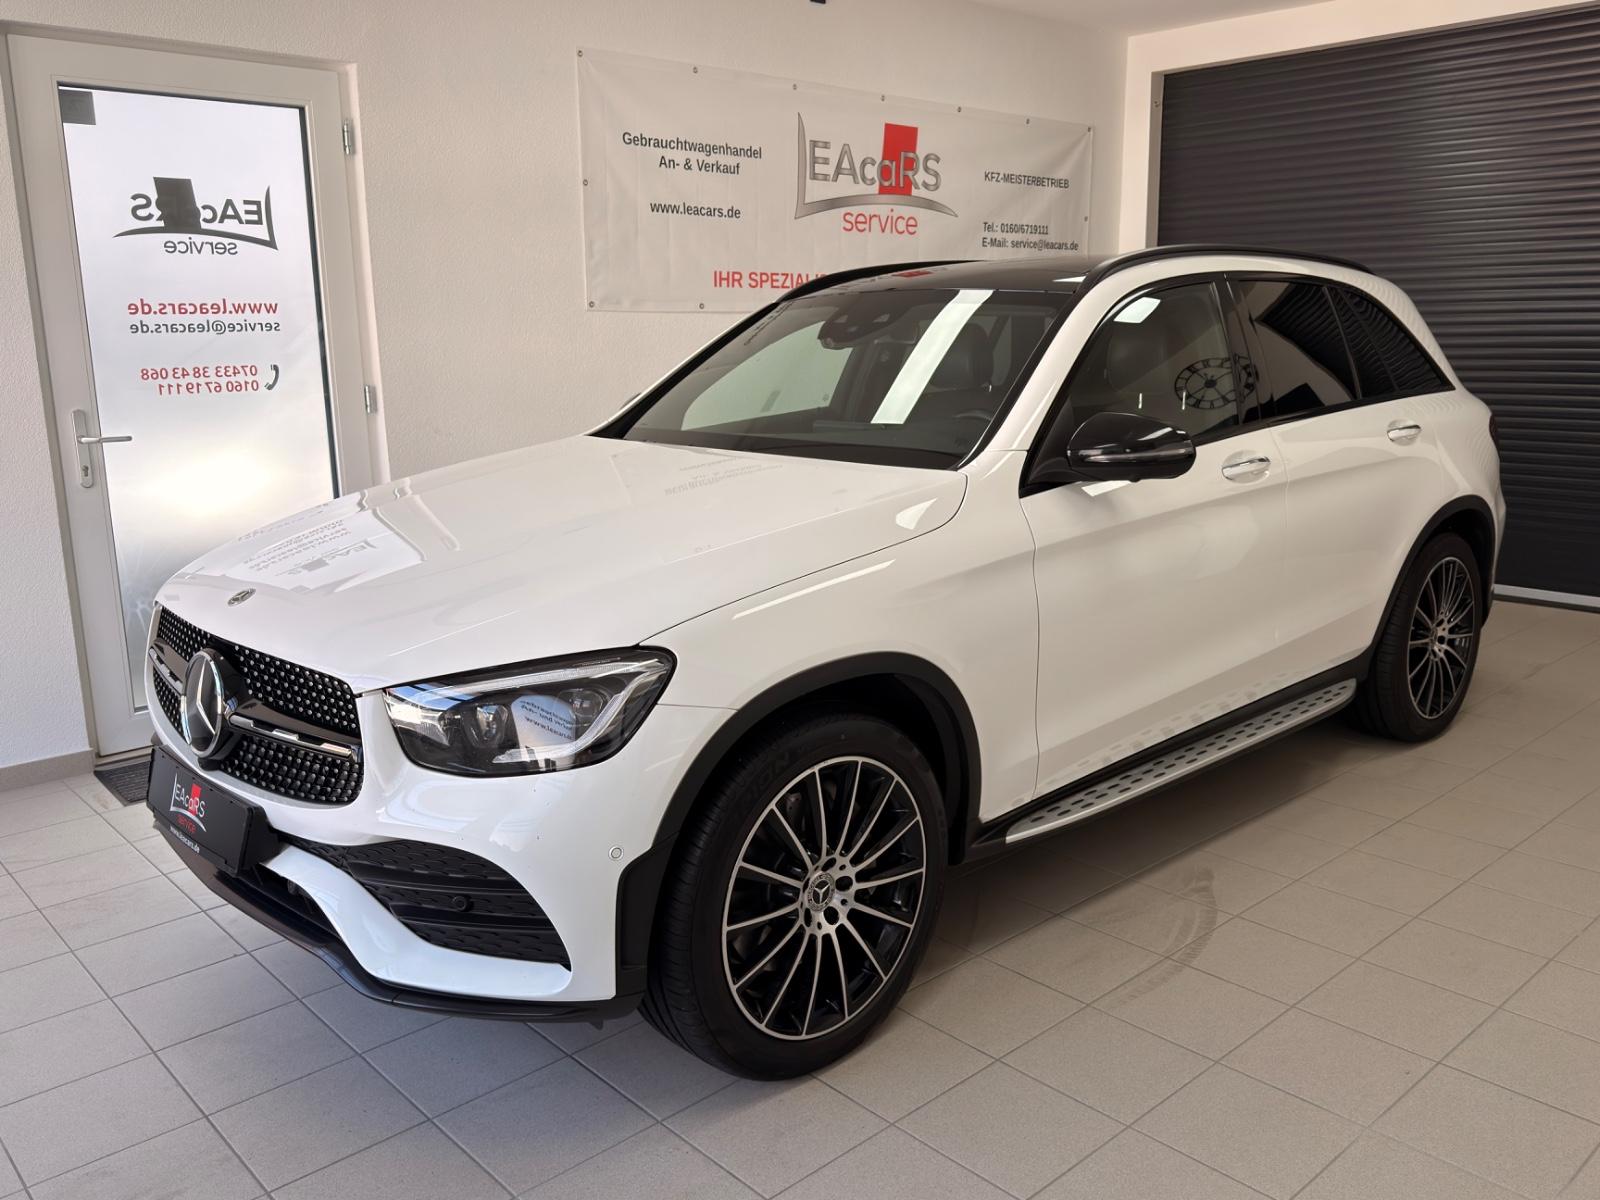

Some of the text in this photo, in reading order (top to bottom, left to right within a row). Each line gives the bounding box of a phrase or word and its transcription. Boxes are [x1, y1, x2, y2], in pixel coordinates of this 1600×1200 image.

[622, 131, 762, 159] Gebrauchtwagenhandel
[659, 155, 741, 175] An- & Verkauf
[984, 171, 1070, 189] KFZ-MEISTERBETRIEB
[650, 202, 741, 219] www.leacars.de
[842, 208, 919, 236] service
[983, 222, 1049, 235] Tel.: 0160/6719111
[982, 237, 1079, 251] E-Mail: service@leacars.de
[713, 271, 743, 288] IHR
